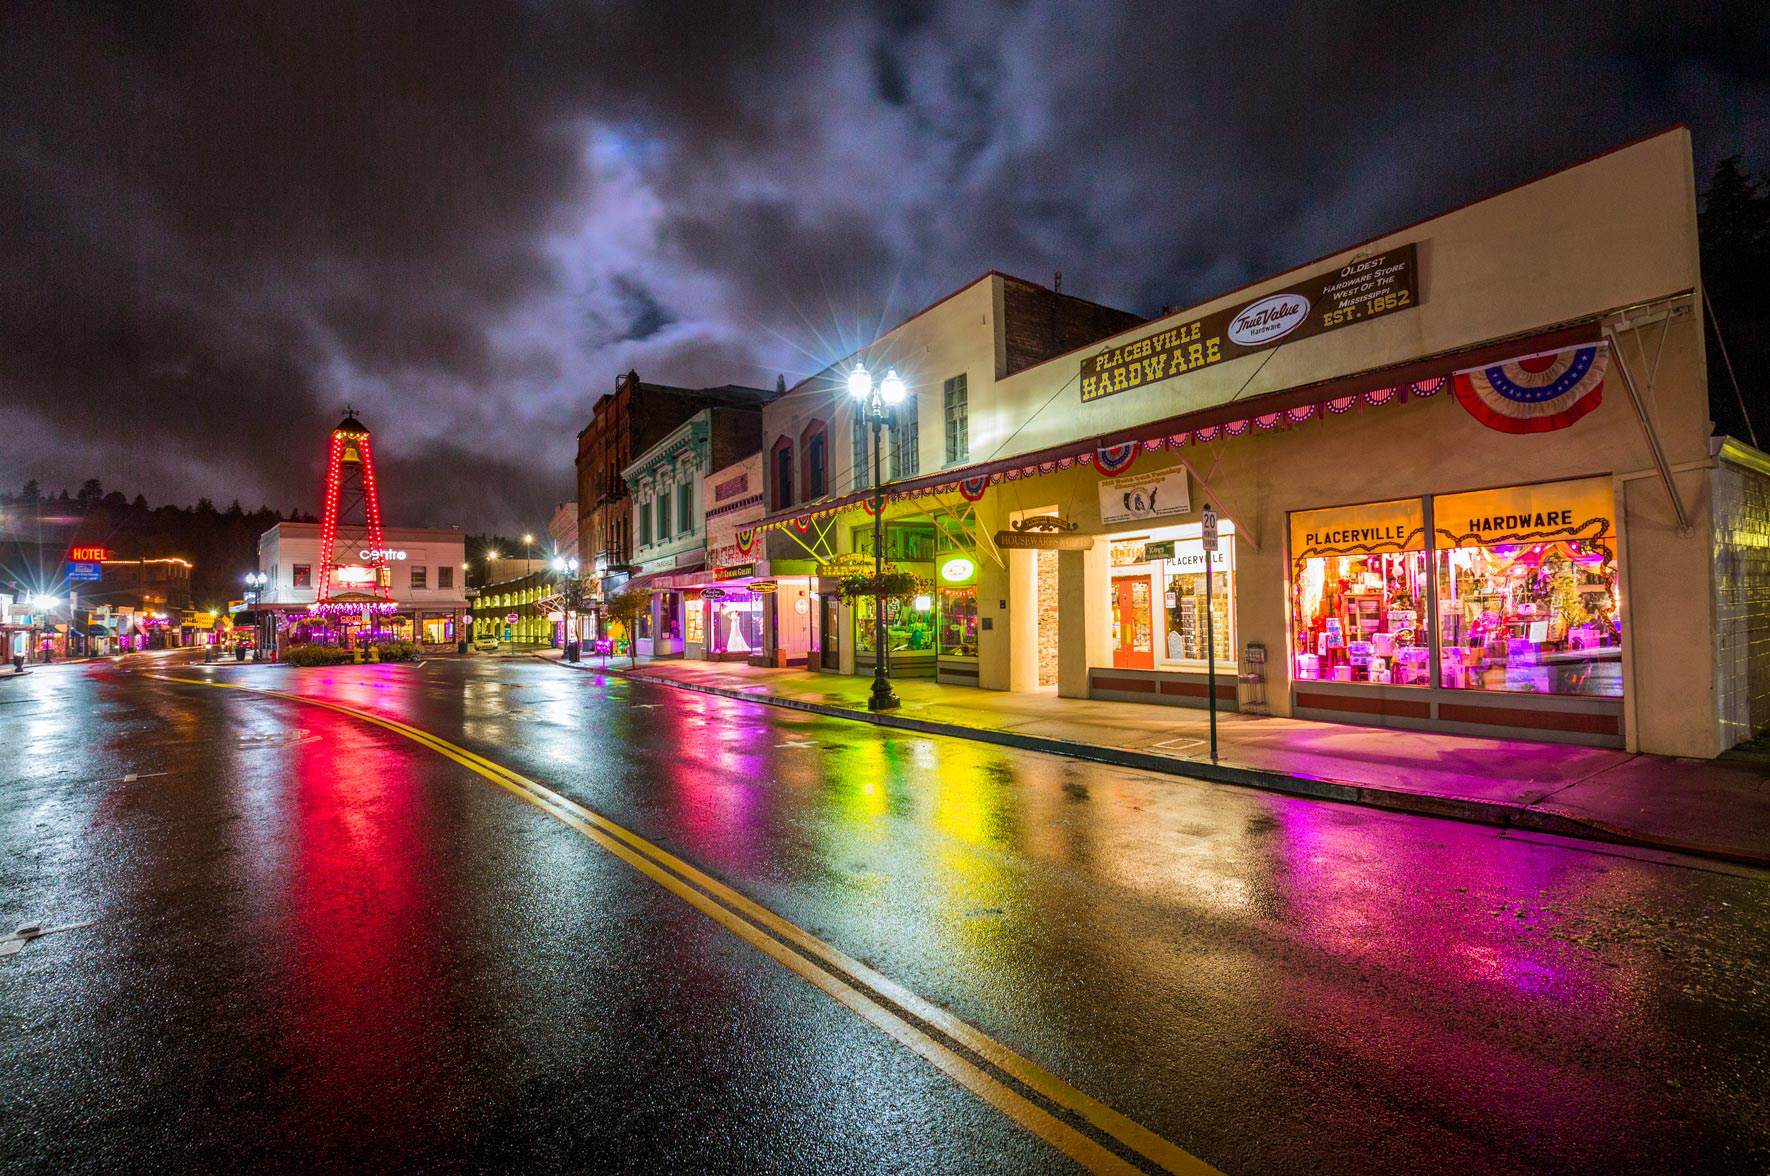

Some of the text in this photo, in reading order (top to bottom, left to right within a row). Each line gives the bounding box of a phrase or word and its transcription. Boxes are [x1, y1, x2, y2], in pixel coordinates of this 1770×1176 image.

[1341, 257, 1386, 277] OLDEST
[1323, 263, 1405, 294] HARDWARE STORE
[1333, 275, 1395, 300] WEST OF THE
[1338, 288, 1390, 308] MISSISSIPPI
[1323, 290, 1410, 327] EST. 1852
[1251, 323, 1281, 336] Hardware
[1096, 322, 1200, 371] PLACERVILLE
[1082, 337, 1221, 400] HARDWARE
[1204, 514, 1216, 528] 20
[1469, 510, 1573, 532] HARDWARE
[1001, 535, 1058, 546] HOUSEWARES
[1306, 526, 1404, 545] PLACERVILLE
[74, 549, 107, 560] HOTEL
[360, 549, 406, 560] centro
[1167, 553, 1223, 566] PLACERVLE
